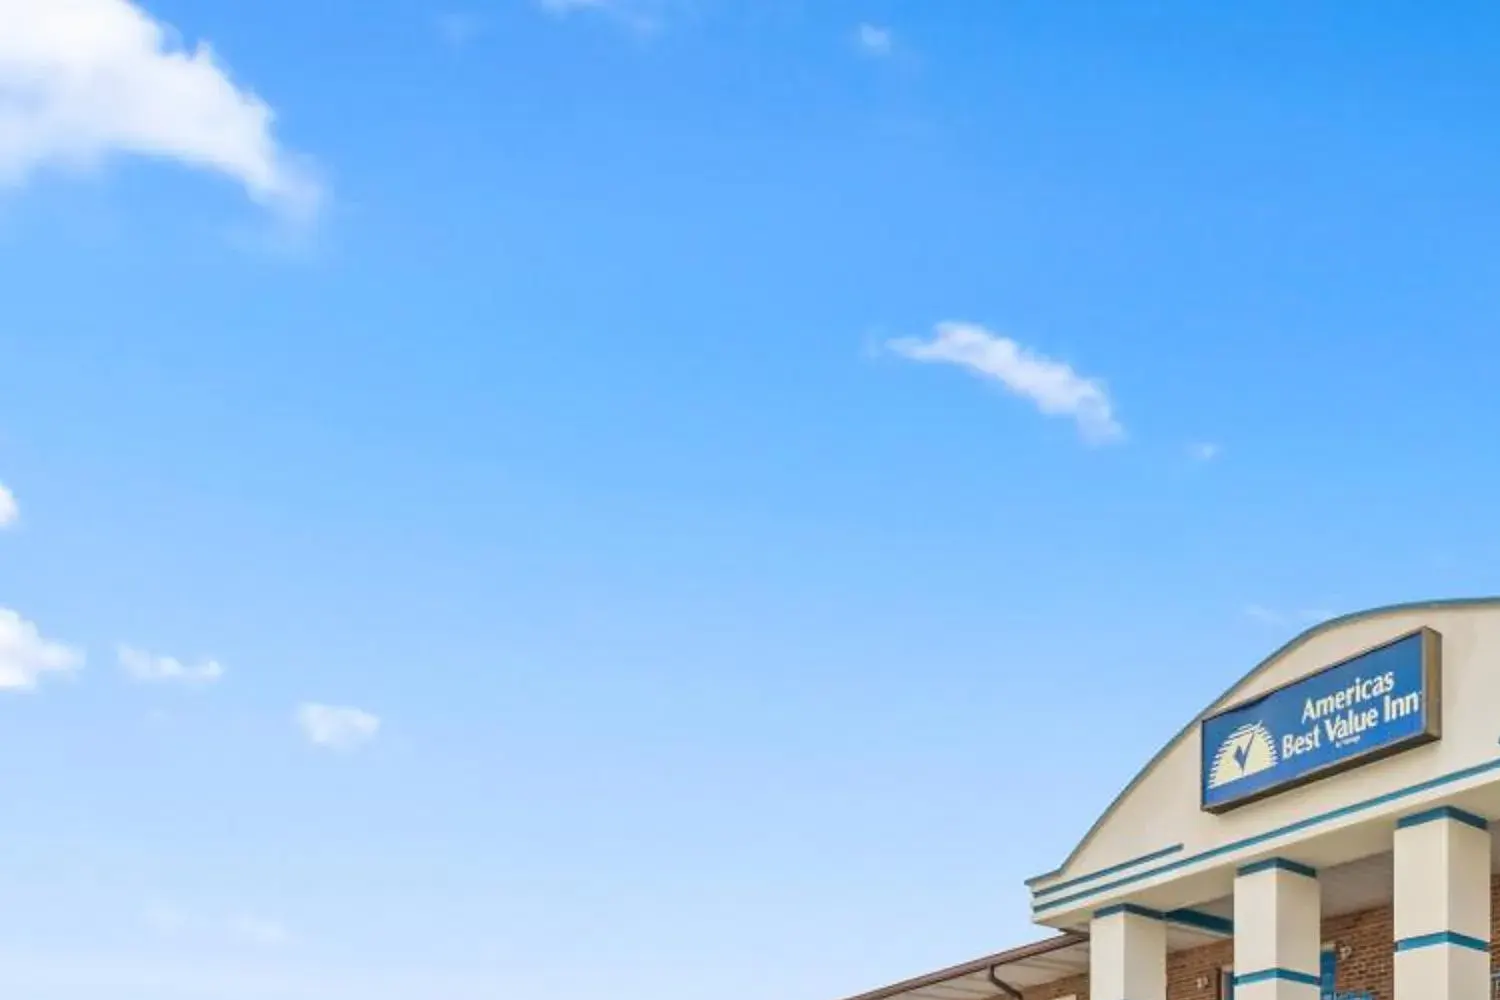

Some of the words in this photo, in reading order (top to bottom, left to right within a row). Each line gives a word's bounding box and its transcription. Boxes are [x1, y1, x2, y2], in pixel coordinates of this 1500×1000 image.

[1282, 724, 1320, 760] Best
[1324, 707, 1378, 742] Value
[1383, 691, 1419, 723] Inn
[1301, 671, 1395, 724] Americas
